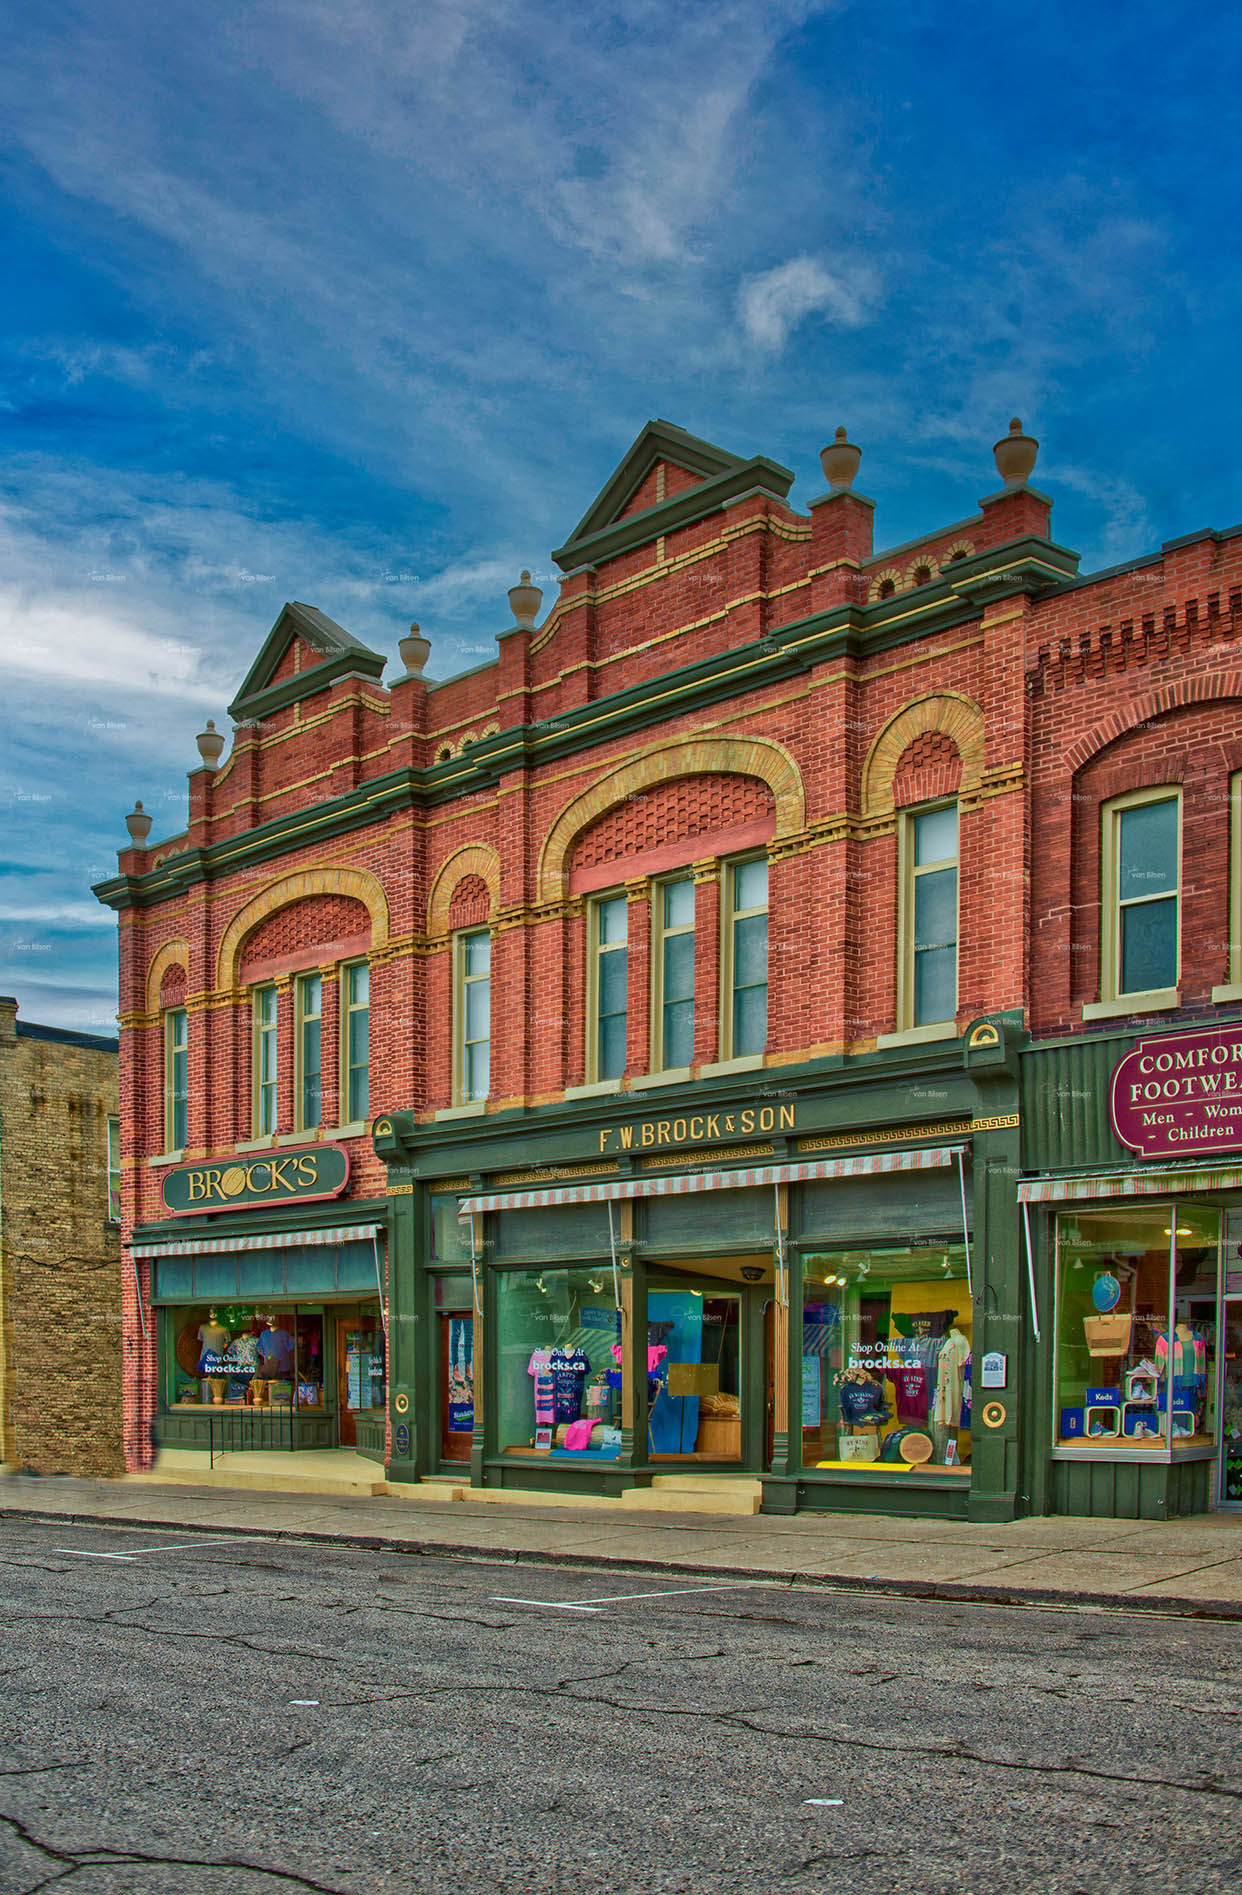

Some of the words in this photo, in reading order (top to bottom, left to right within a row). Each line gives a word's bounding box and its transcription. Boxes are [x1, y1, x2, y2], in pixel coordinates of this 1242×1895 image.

[1130, 1070, 1242, 1102] FOOTWE
[741, 1103, 796, 1135] SON
[1142, 1112, 1175, 1126] Men
[1168, 1125, 1234, 1142] Children
[575, 1348, 585, 1356] At
[850, 1341, 873, 1354] Shop
[874, 1341, 906, 1353] Online
[908, 1343, 920, 1352] At
[206, 1354, 222, 1364] Shop
[533, 1359, 586, 1371] brocks.ca
[848, 1356, 921, 1369] brocks.ca
[204, 1364, 256, 1374] brocks.ca
[1095, 1392, 1113, 1401] Keds
